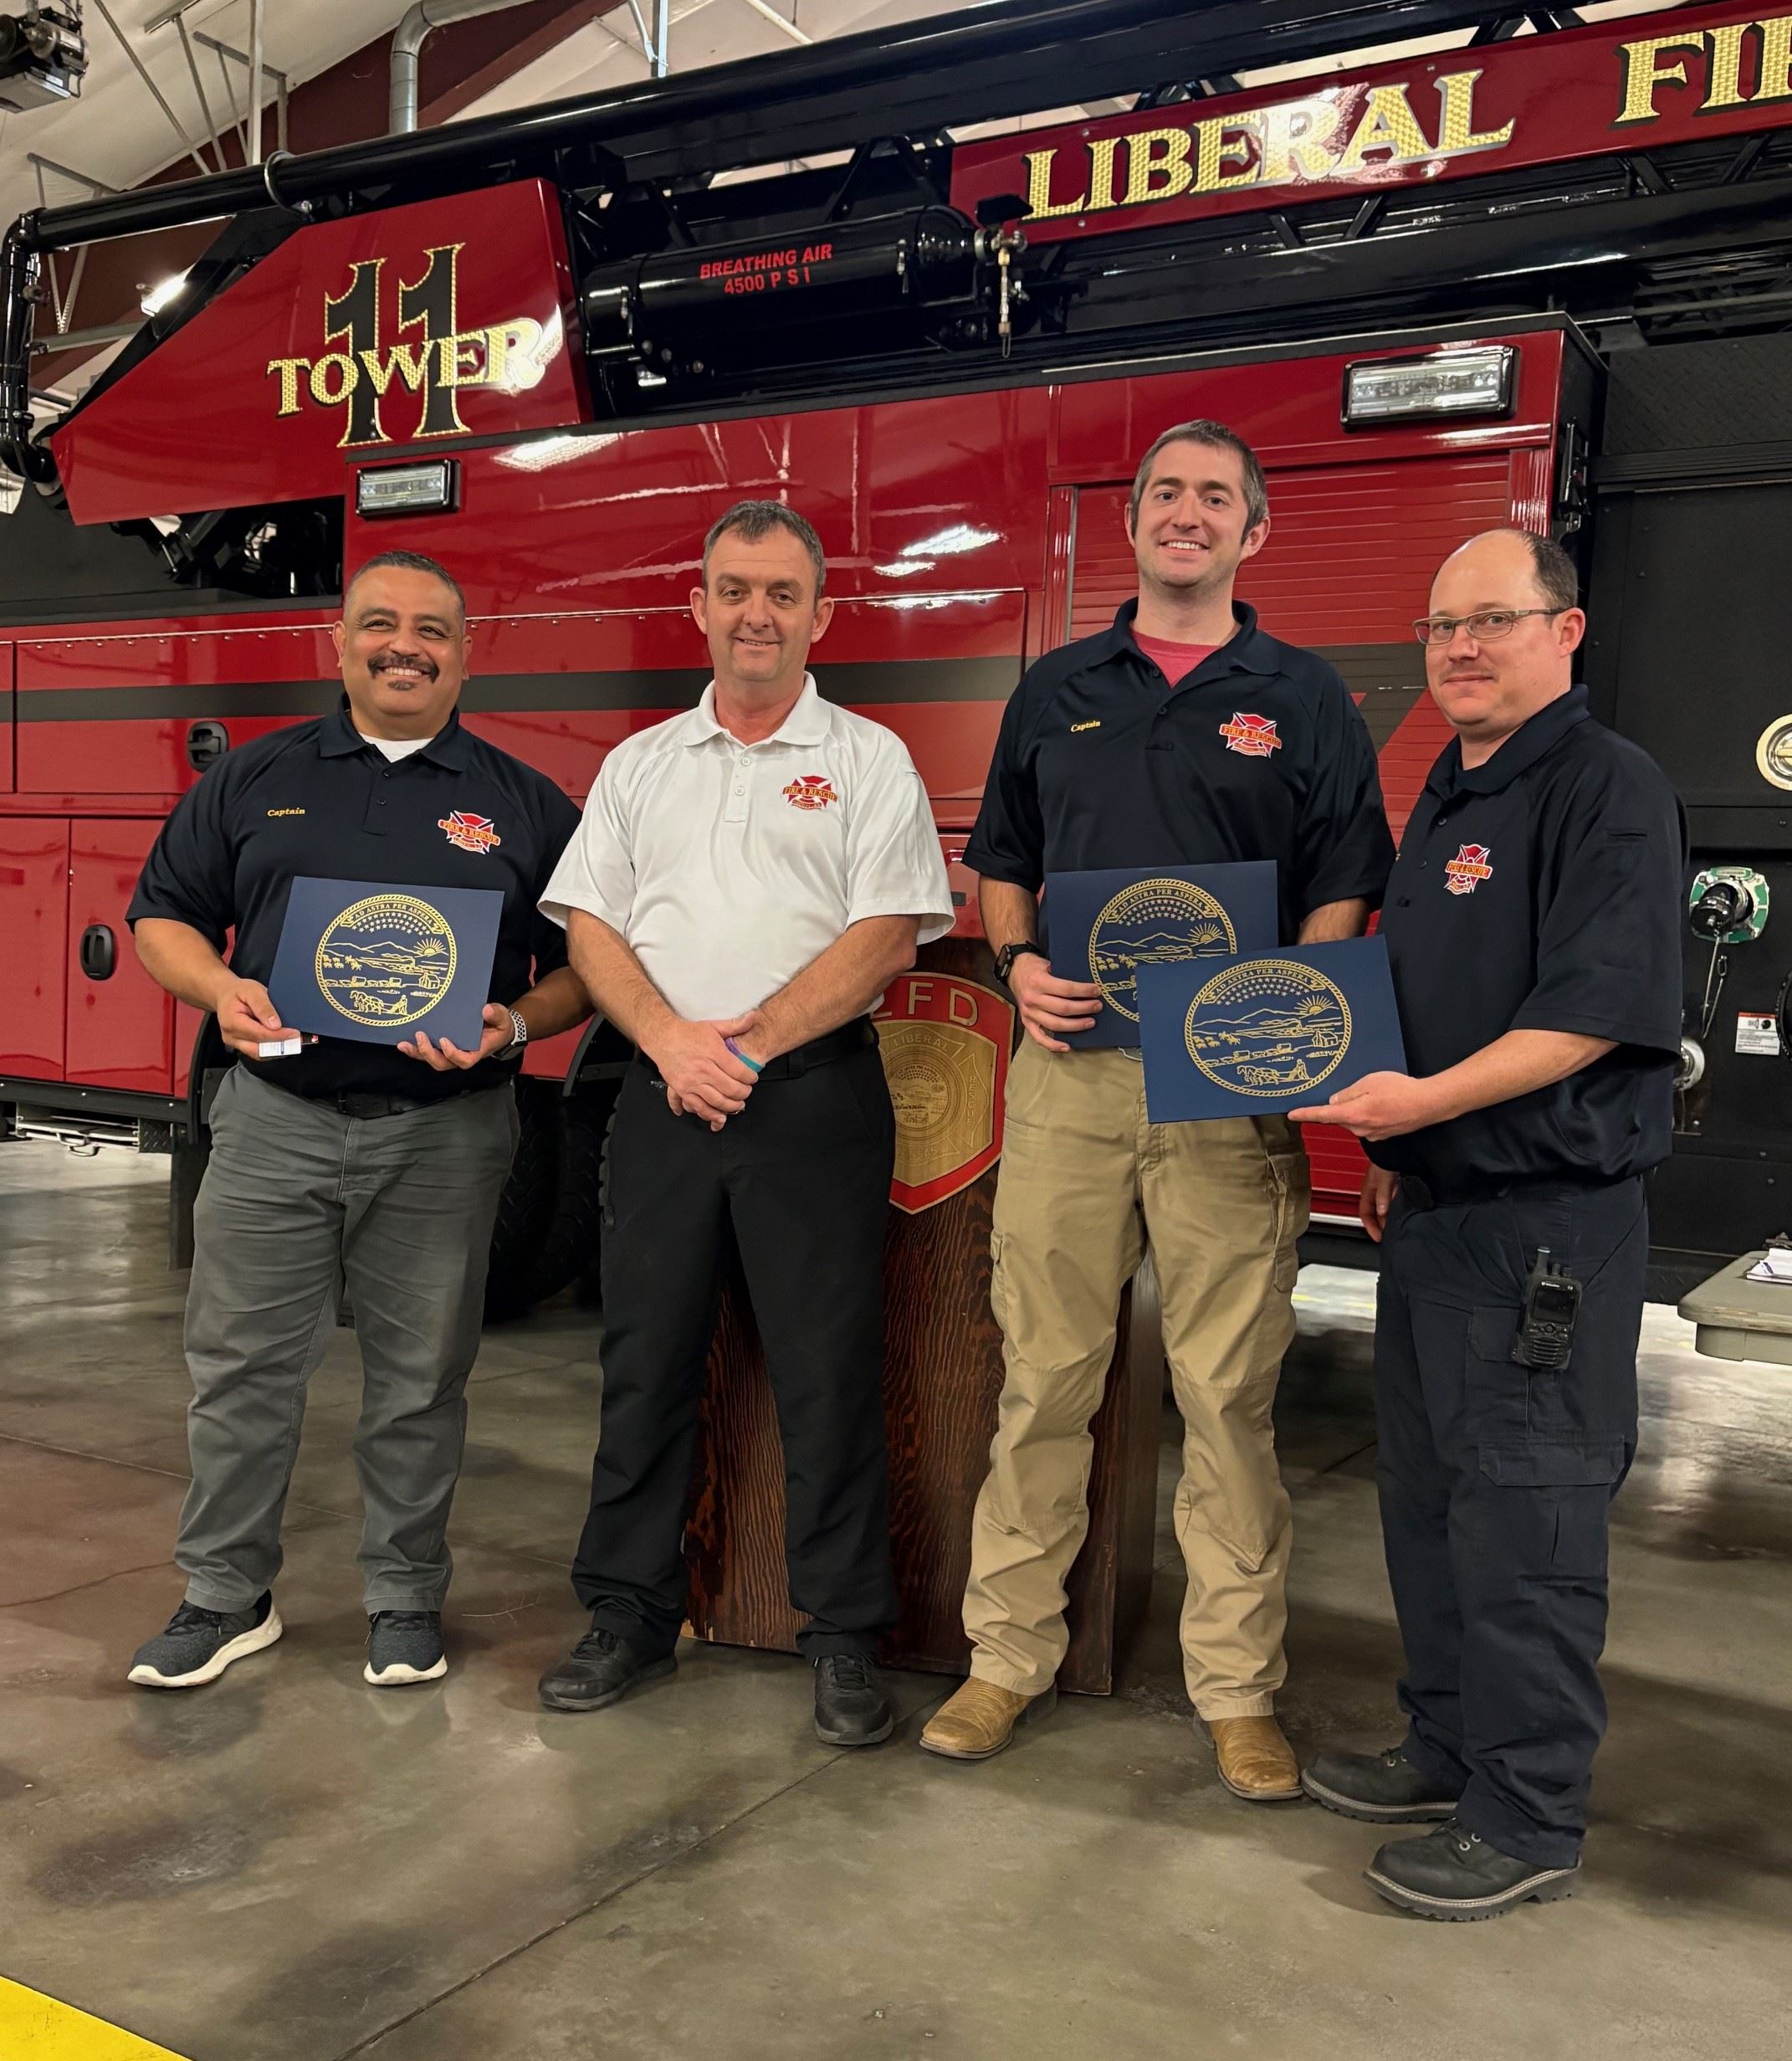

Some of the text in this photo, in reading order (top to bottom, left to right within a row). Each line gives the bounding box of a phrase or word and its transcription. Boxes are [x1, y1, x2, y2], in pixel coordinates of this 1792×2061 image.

[1021, 69, 1515, 221] LIBERAL
[699, 244, 832, 279] BREATHING AIR
[724, 274, 765, 295] 4500
[325, 243, 473, 448] 11
[265, 317, 546, 417] TOWER
[1070, 720, 1101, 732] Captain
[1223, 726, 1242, 736] FIRE
[1251, 731, 1280, 746] RESCUE
[808, 788, 837, 801] RESCUE
[267, 807, 305, 817] Captain
[443, 822, 460, 832] FIRE
[468, 829, 497, 843] RESCUE
[1118, 902, 1129, 911] AD
[1129, 890, 1154, 902] ASTRA
[1174, 890, 1203, 907] ASPERA
[355, 910, 365, 919] AD
[366, 903, 390, 914] ASTRA
[407, 905, 433, 924] ASPERA
[1216, 983, 1226, 993] AD
[1227, 970, 1254, 983] ASTRA
[1276, 969, 1309, 982] ASPERA
[893, 1033, 948, 1052] LIBERAL
[966, 1075, 977, 1125] RESCUE
